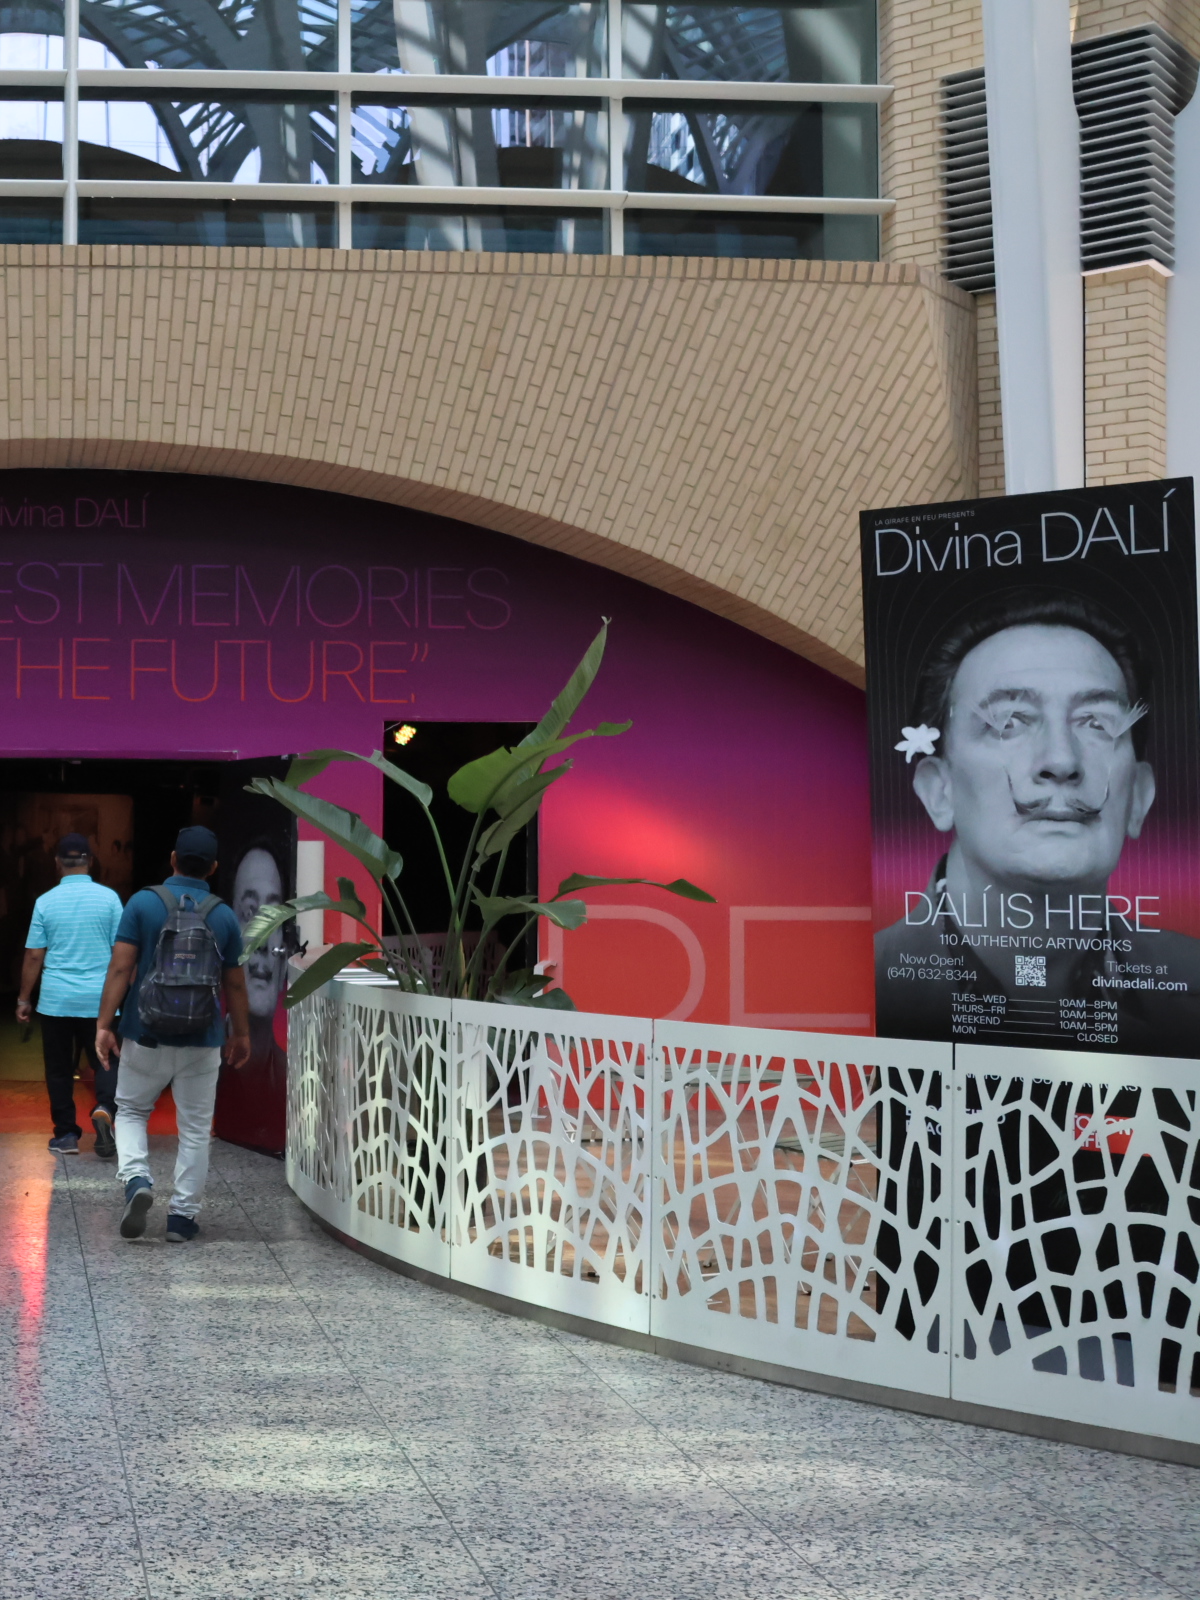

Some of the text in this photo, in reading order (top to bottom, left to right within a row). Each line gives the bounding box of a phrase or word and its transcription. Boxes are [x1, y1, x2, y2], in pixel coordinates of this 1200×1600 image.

[75, 491, 150, 528] DALÍ
[885, 517, 909, 525] GIRAFE
[938, 510, 975, 519] PRESENTS
[875, 487, 1177, 576] Divina DALÍ
[116, 563, 512, 630] MEMORIES
[905, 884, 1161, 933] DALÍ IS HERE
[939, 934, 1132, 952] 110 AUTHENTIC ARTWORKS
[900, 953, 964, 968] Now Open!
[1106, 960, 1168, 975] Tickets at
[887, 967, 978, 982] (647) 632-8344
[1092, 975, 1188, 991] divinadali.com
[952, 1015, 1001, 1025] WEEKEND
[952, 1025, 1119, 1044] MON CLOSED
